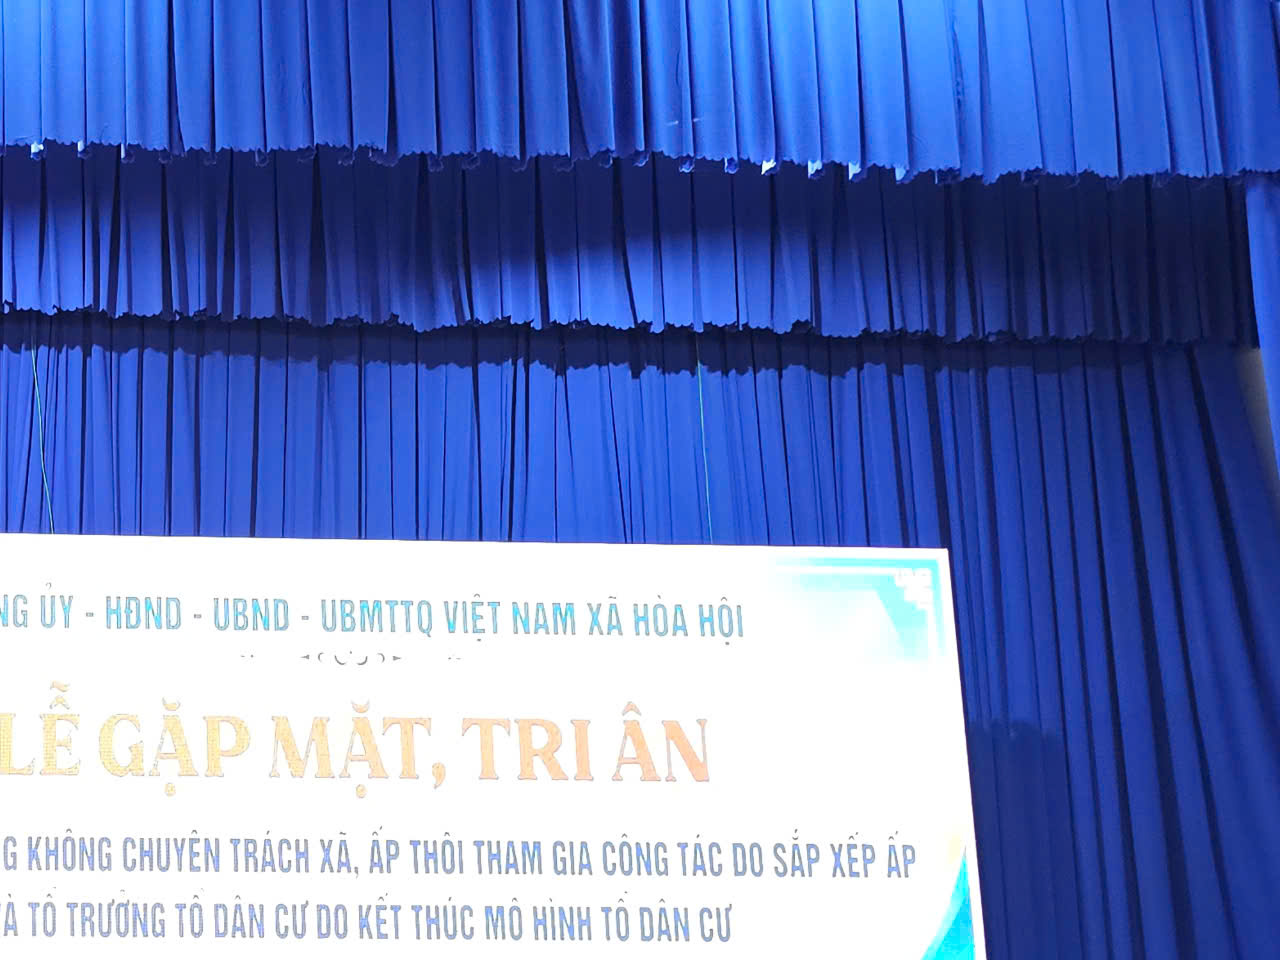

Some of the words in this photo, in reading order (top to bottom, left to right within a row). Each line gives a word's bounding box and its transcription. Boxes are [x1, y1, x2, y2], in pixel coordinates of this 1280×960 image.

[39, 582, 74, 629] ỦY
[105, 595, 182, 630] HĐND
[213, 597, 290, 632] UBND
[320, 599, 433, 638] UBMTTQ
[443, 593, 501, 642] VIỆT
[511, 601, 577, 636] NAM
[586, 596, 624, 637] XÃ
[632, 594, 689, 638] HÒA
[697, 596, 744, 645] HỘI
[98, 697, 252, 797] GẶP
[268, 700, 447, 799] MẶT,
[461, 717, 595, 782] TRI
[611, 701, 710, 783] ÂN
[27, 827, 113, 872] KHÔNG
[122, 829, 221, 873] CHUYÊN
[229, 829, 310, 873] TRÁCH
[319, 831, 359, 878] XÃ,
[368, 825, 400, 874] ẤP
[408, 831, 465, 875] THÔI
[472, 839, 544, 875] THAM
[552, 839, 593, 877] GIA
[601, 832, 669, 877] CÔNG
[676, 833, 723, 878] TÁC
[731, 841, 764, 878] DO
[772, 828, 821, 879] SẮP
[829, 831, 876, 879] XẾP
[886, 830, 916, 879] ẤP
[213, 894, 265, 939] DÂN
[274, 899, 310, 940] CƯ
[315, 903, 349, 940] DO
[357, 892, 402, 940] KẾT
[410, 896, 475, 941] THÚC
[484, 896, 524, 942] MÔ
[532, 897, 593, 942] HÌNH
[638, 897, 691, 943] DÂN
[698, 903, 733, 943] CƯ
